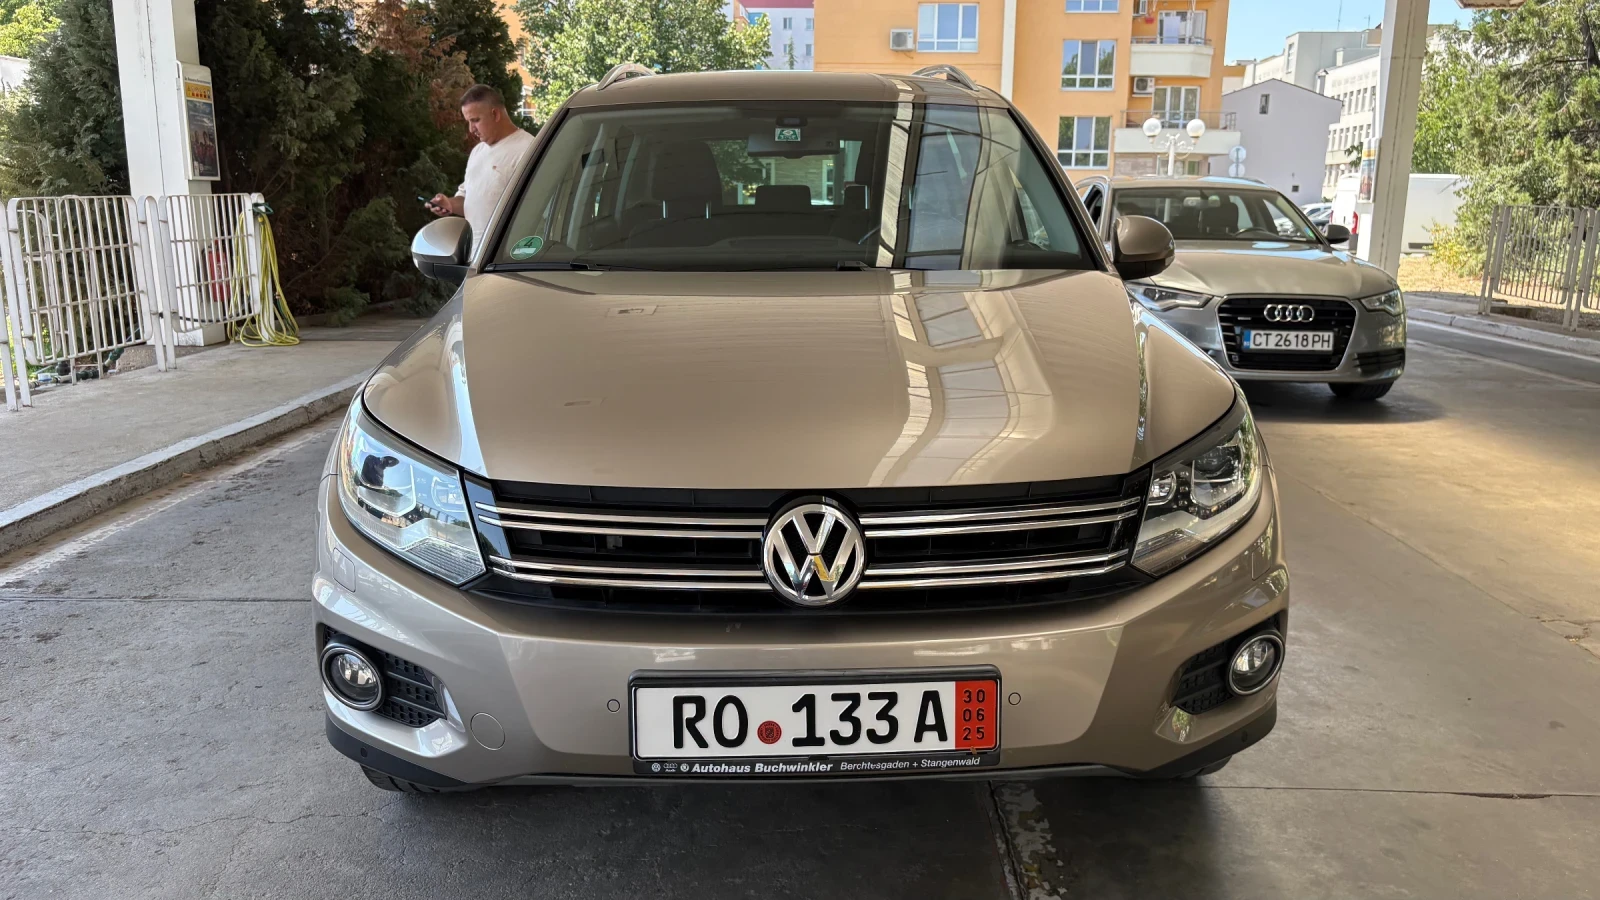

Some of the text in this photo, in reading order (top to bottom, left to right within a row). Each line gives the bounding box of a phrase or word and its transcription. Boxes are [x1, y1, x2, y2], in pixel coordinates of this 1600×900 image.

[524, 237, 535, 248] 4
[1252, 332, 1331, 348] CT 2618 PH
[963, 688, 985, 703] 30
[672, 694, 749, 749] RO
[791, 691, 899, 746] 133
[914, 690, 948, 743] A
[963, 708, 984, 722] 06
[962, 726, 984, 740] 25
[691, 763, 750, 773] Autohaus
[754, 763, 833, 773] Buchwinkler
[920, 757, 981, 768] Stangenwald
